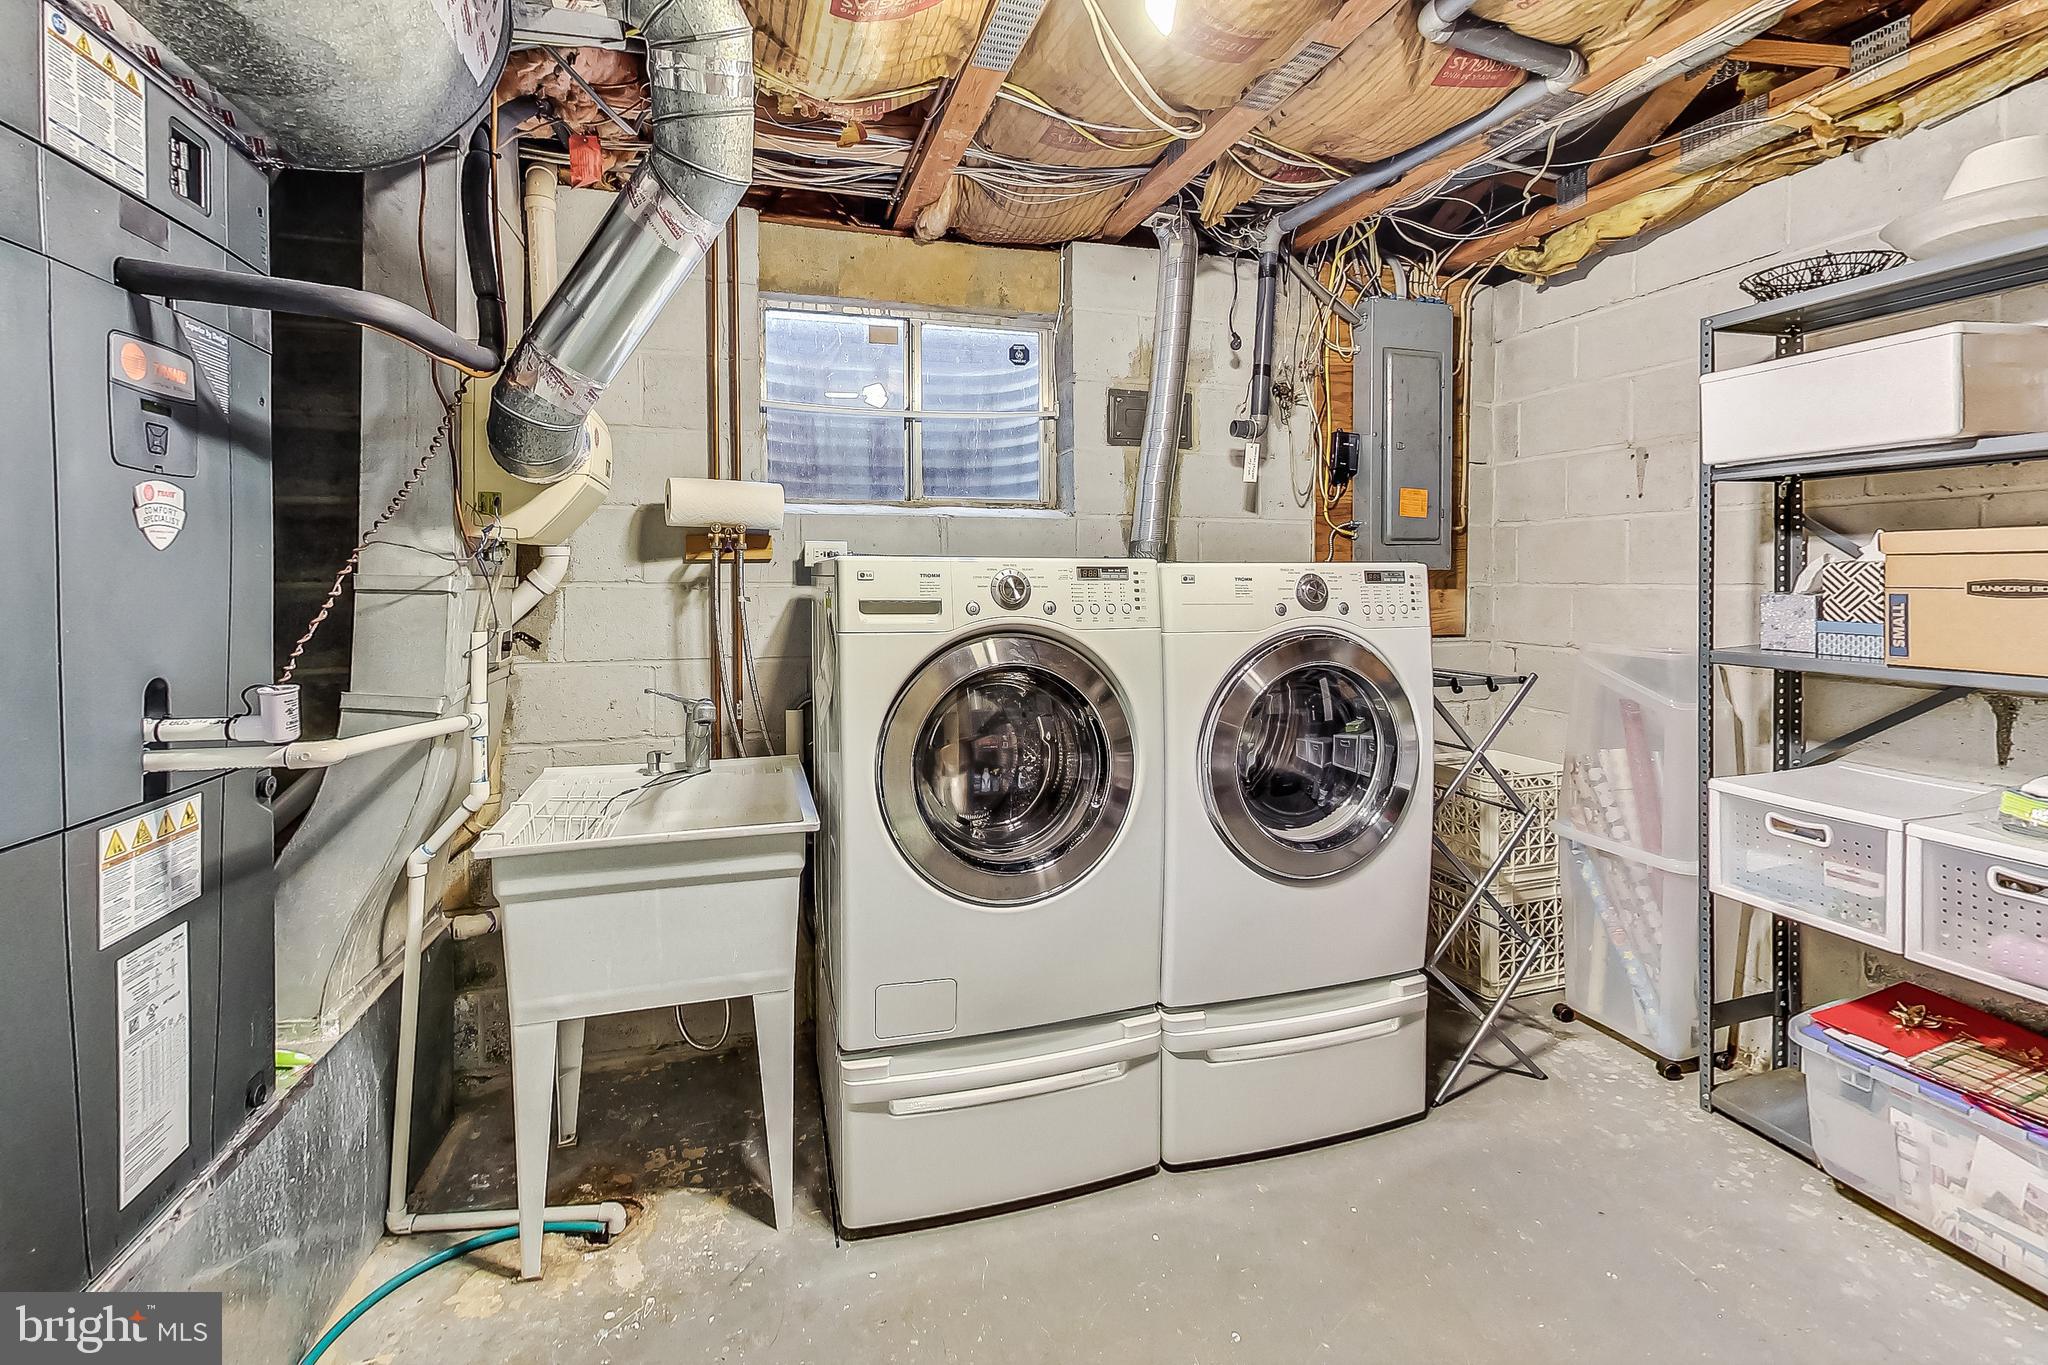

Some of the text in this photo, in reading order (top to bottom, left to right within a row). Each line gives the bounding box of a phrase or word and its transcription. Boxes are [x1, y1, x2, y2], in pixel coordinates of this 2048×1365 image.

[144, 506, 178, 517] COMFORT
[1971, 584, 2031, 593] BANKERS
[1892, 602, 1906, 648] SMALL
